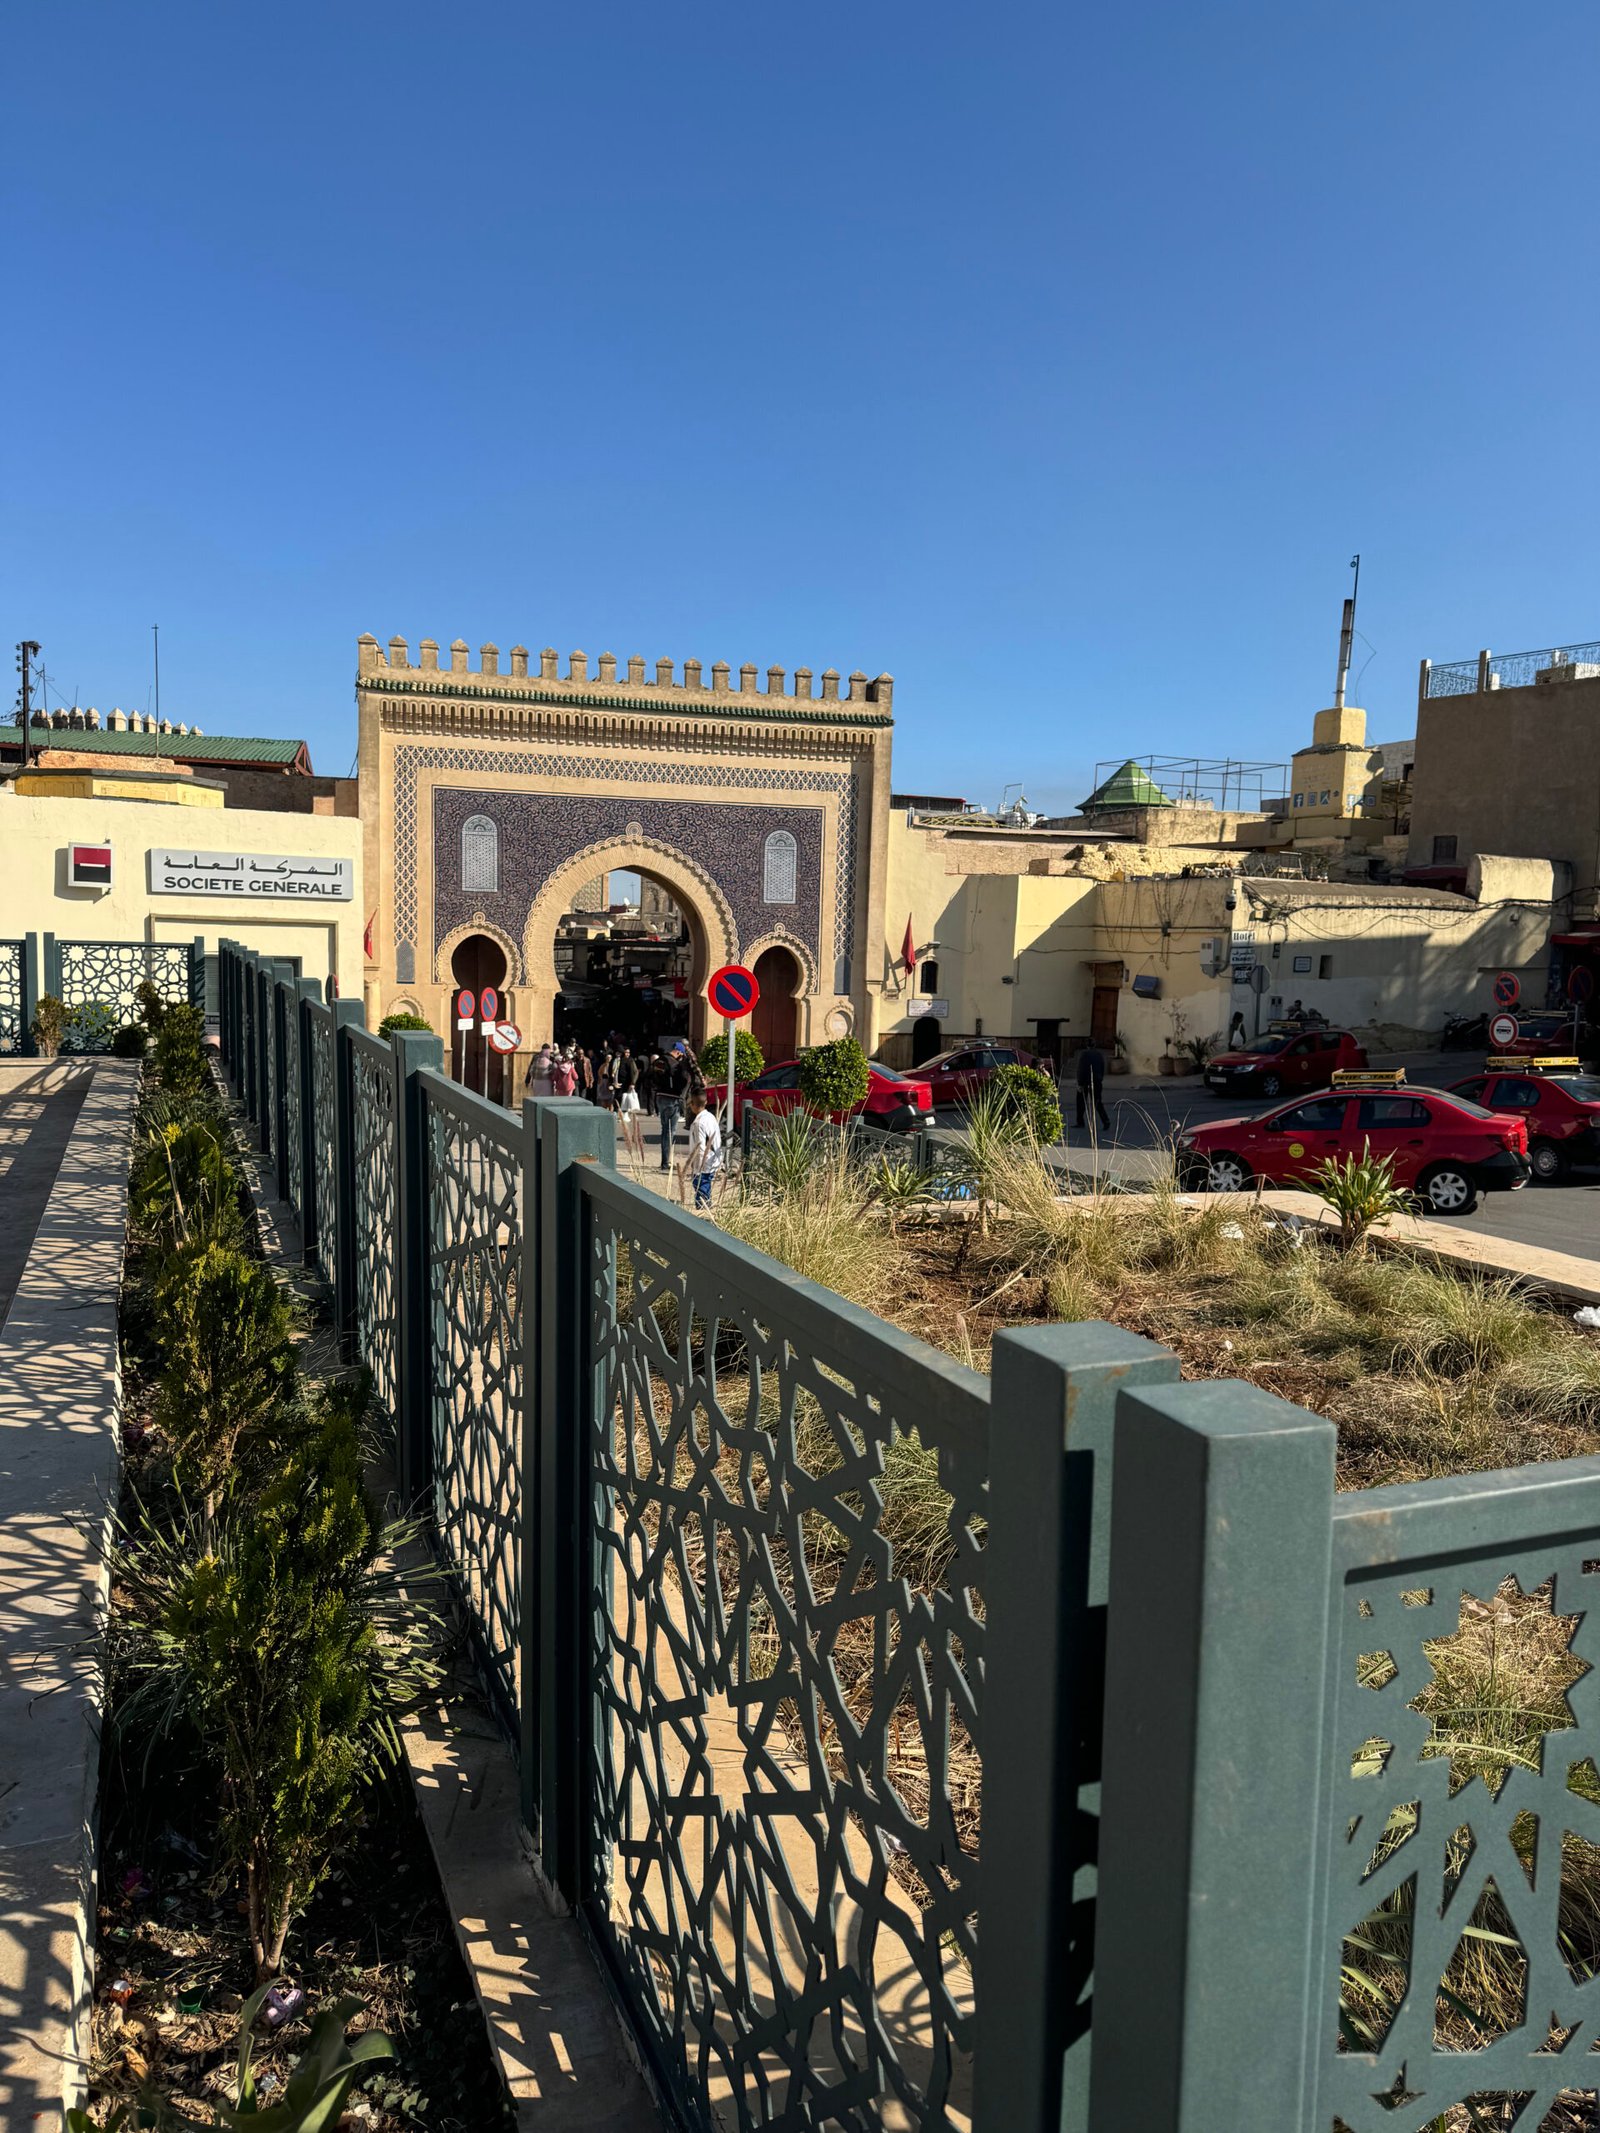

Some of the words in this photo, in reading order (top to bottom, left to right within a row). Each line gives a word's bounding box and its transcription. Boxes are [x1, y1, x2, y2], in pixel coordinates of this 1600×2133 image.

[163, 855, 245, 871] العامة
[249, 859, 343, 880] الشركة
[164, 876, 244, 891] SOCIETE
[249, 880, 342, 895] GENERALE
